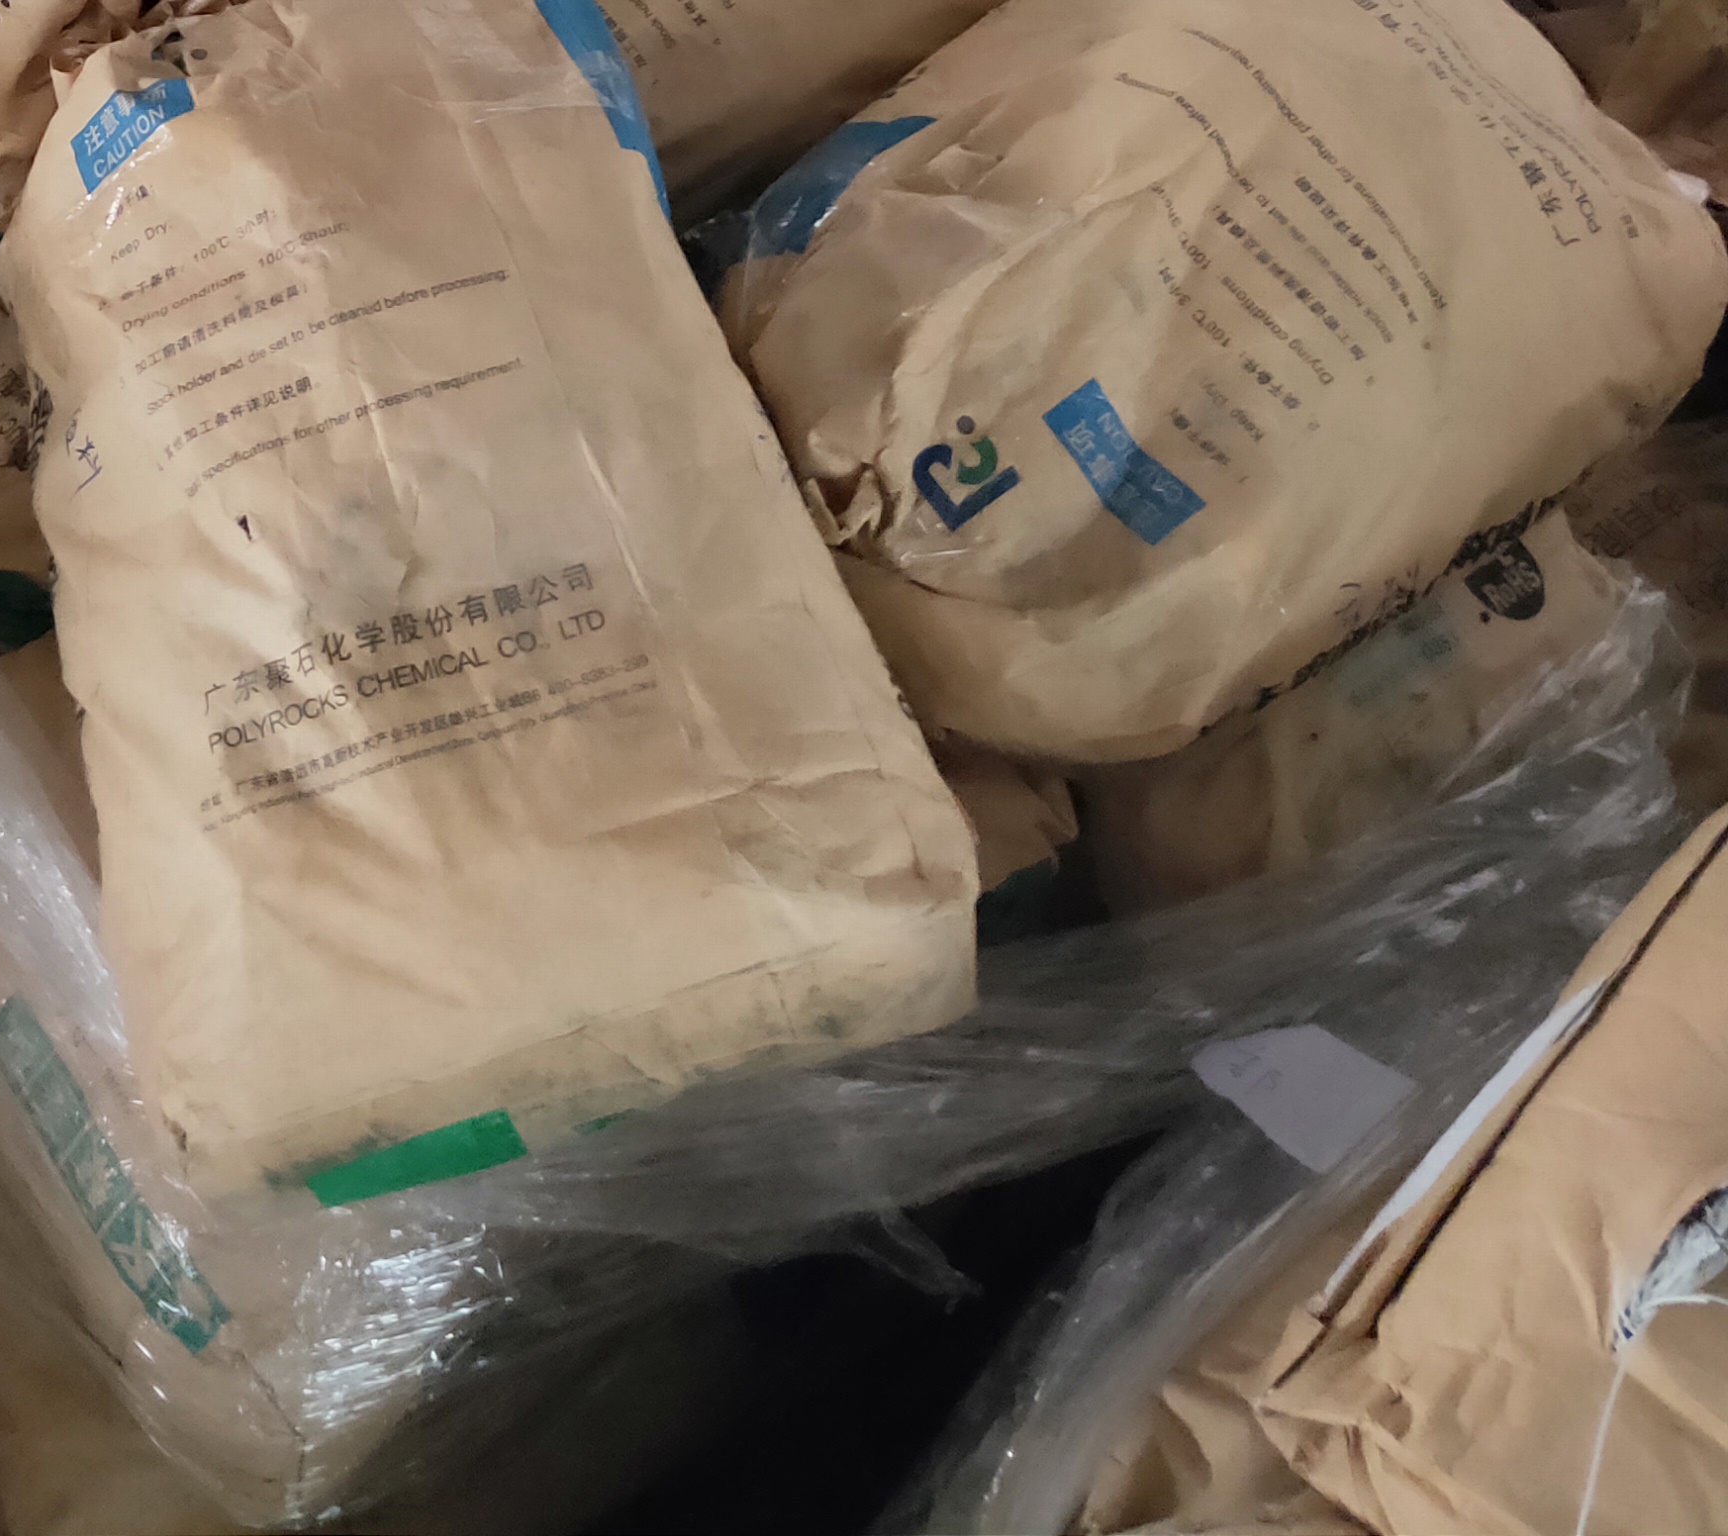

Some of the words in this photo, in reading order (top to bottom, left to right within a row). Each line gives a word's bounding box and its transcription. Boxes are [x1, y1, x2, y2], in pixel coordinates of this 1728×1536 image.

[89, 104, 168, 180] CAUTION
[1303, 129, 1340, 170] other
[1331, 160, 1358, 186] for
[1413, 265, 1450, 311] Read
[118, 299, 170, 336] Drying
[174, 365, 219, 397] holder
[215, 355, 246, 379] and
[265, 333, 291, 356] set
[288, 325, 307, 345] to
[306, 316, 329, 337] be
[382, 284, 430, 311] before
[1283, 334, 1338, 389] Drying
[290, 422, 316, 444] for
[312, 408, 353, 437] other
[351, 381, 435, 422] processing
[1481, 565, 1542, 614] RoHS
[196, 560, 596, 717] 广东聚石化学股份有限公司
[205, 683, 351, 755] POLYROCKS
[353, 642, 488, 701] CHEMICAL
[556, 605, 608, 642] LTD
